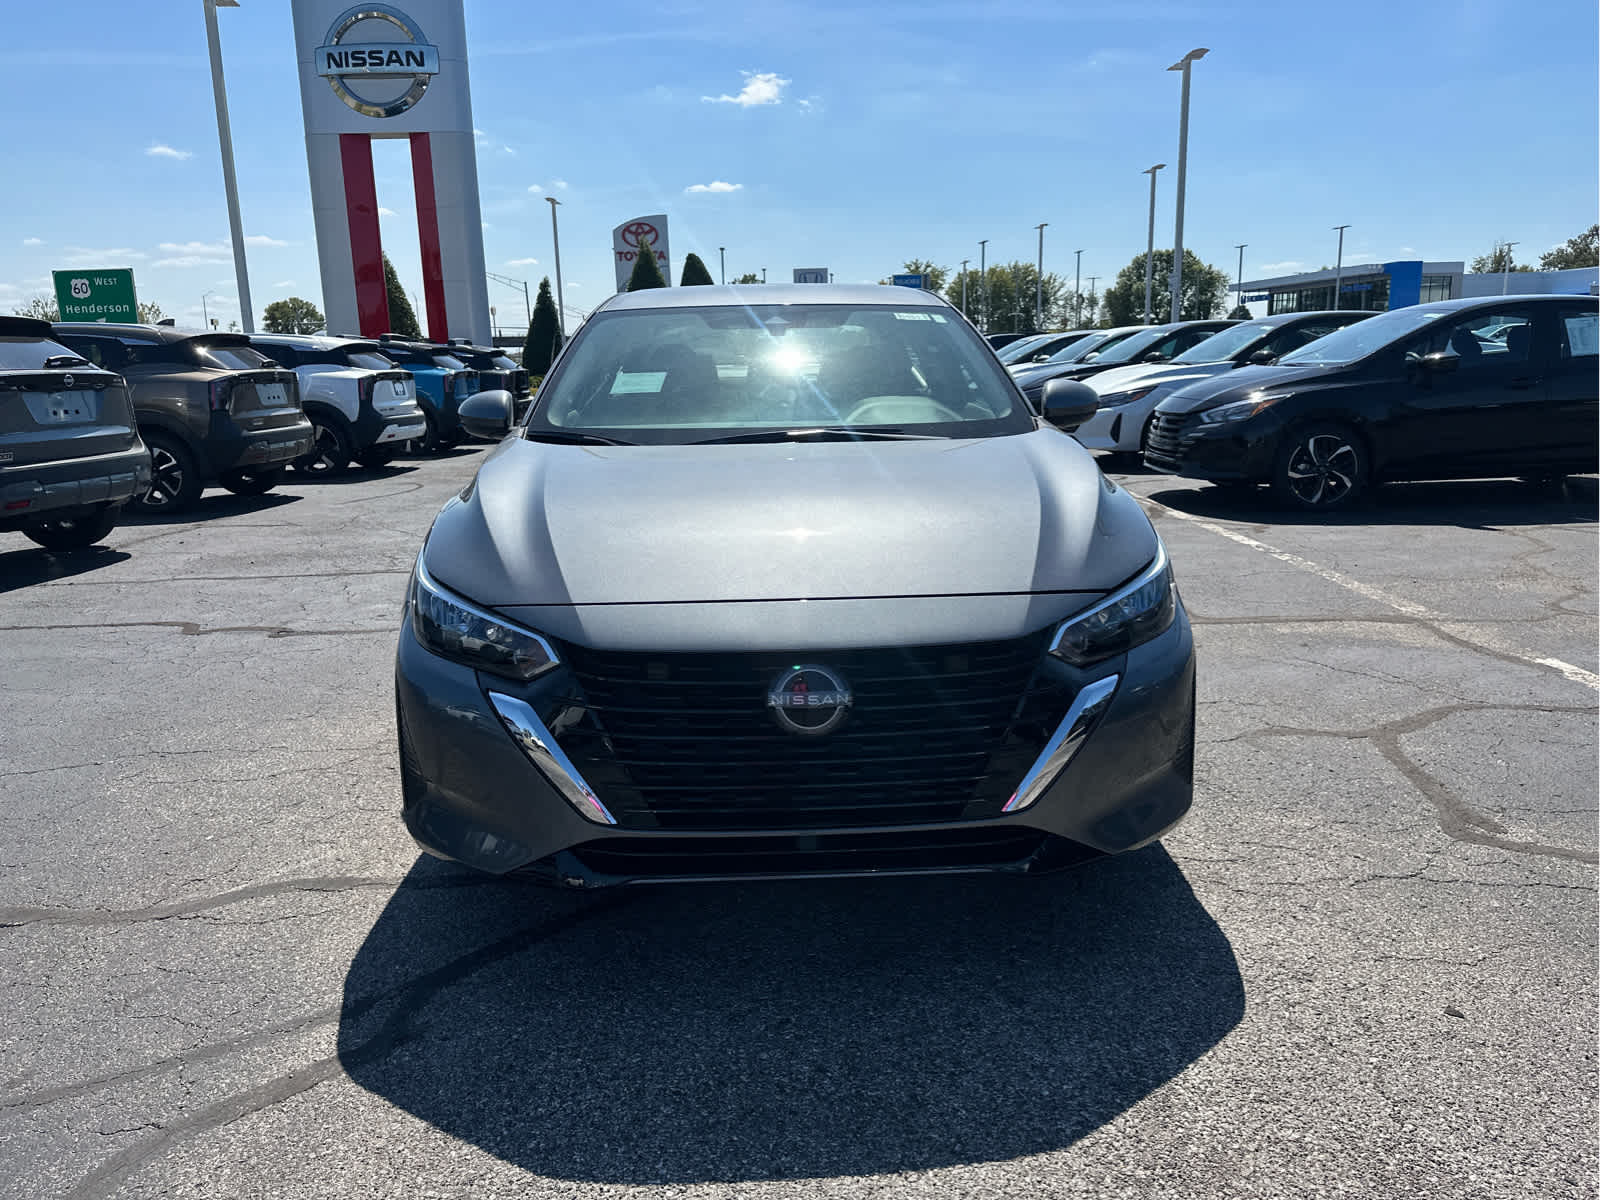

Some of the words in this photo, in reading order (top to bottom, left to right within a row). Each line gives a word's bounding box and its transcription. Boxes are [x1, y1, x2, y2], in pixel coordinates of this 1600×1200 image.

[326, 49, 425, 69] NISSAN
[616, 250, 667, 262] TOYA
[73, 282, 89, 295] 60
[94, 277, 118, 286] WEST
[65, 304, 130, 314] Henderson
[770, 694, 850, 705] NISSAN
